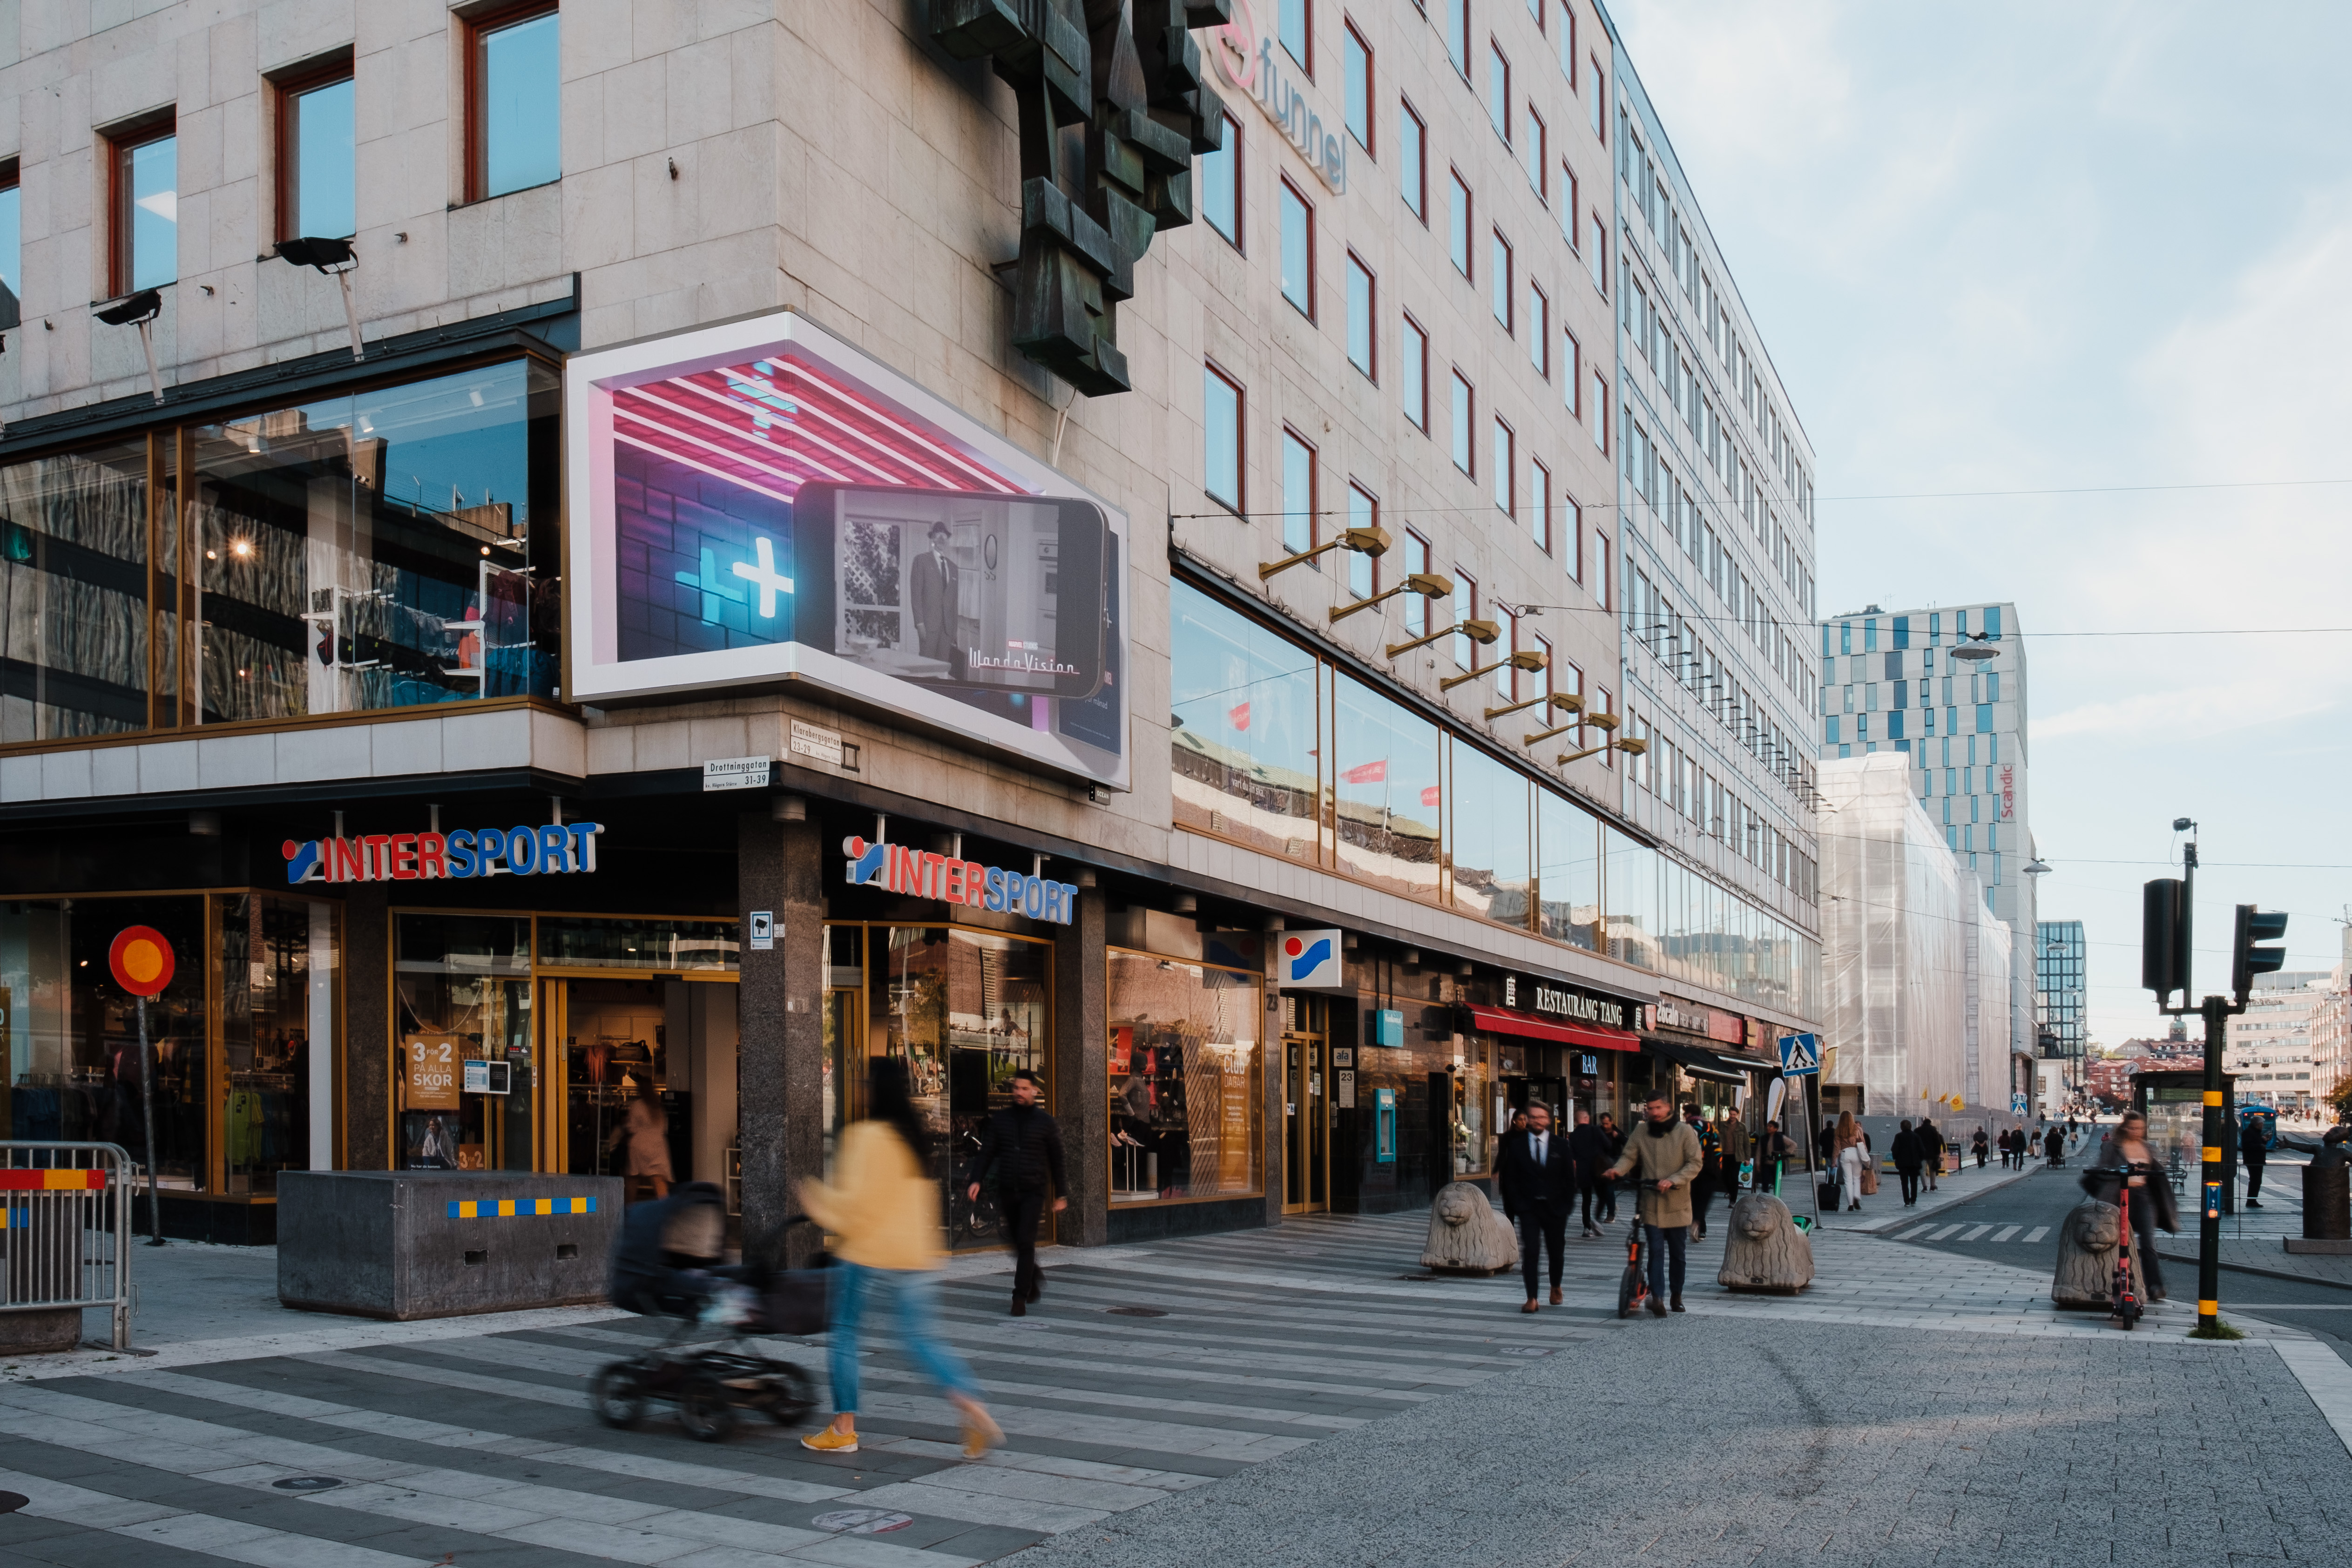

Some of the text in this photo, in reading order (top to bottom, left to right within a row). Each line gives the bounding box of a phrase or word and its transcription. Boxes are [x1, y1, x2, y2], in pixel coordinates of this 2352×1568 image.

[1260, 37, 1346, 196] funnel
[1093, 697, 1108, 709] månad
[793, 723, 840, 747] Klarabergsgatan
[793, 741, 811, 754] 23-29
[710, 761, 766, 772] Drottninggatan
[745, 775, 766, 785] 31-39
[1096, 790, 1109, 799] OCEAN
[2000, 765, 2013, 818] Scandic
[323, 823, 604, 883] INTERSPORT
[883, 843, 1078, 926] INTERSPORT
[1506, 977, 1516, 1007] 唐
[1266, 994, 1278, 1012] 23
[1536, 987, 1622, 1025] RESTAURANG TANG
[413, 1042, 426, 1062] 3
[439, 1042, 452, 1062] 2
[1336, 1050, 1349, 1060] afa
[414, 1061, 452, 1073] PÅ ALLA
[1224, 1054, 1245, 1075] Club
[1582, 1054, 1598, 1075] BAR
[413, 1074, 453, 1087] SKOR
[1224, 1075, 1245, 1088] DAGAR
[1341, 1073, 1352, 1081] 23
[460, 1151, 468, 1169] 3
[474, 1150, 484, 1168] 2
